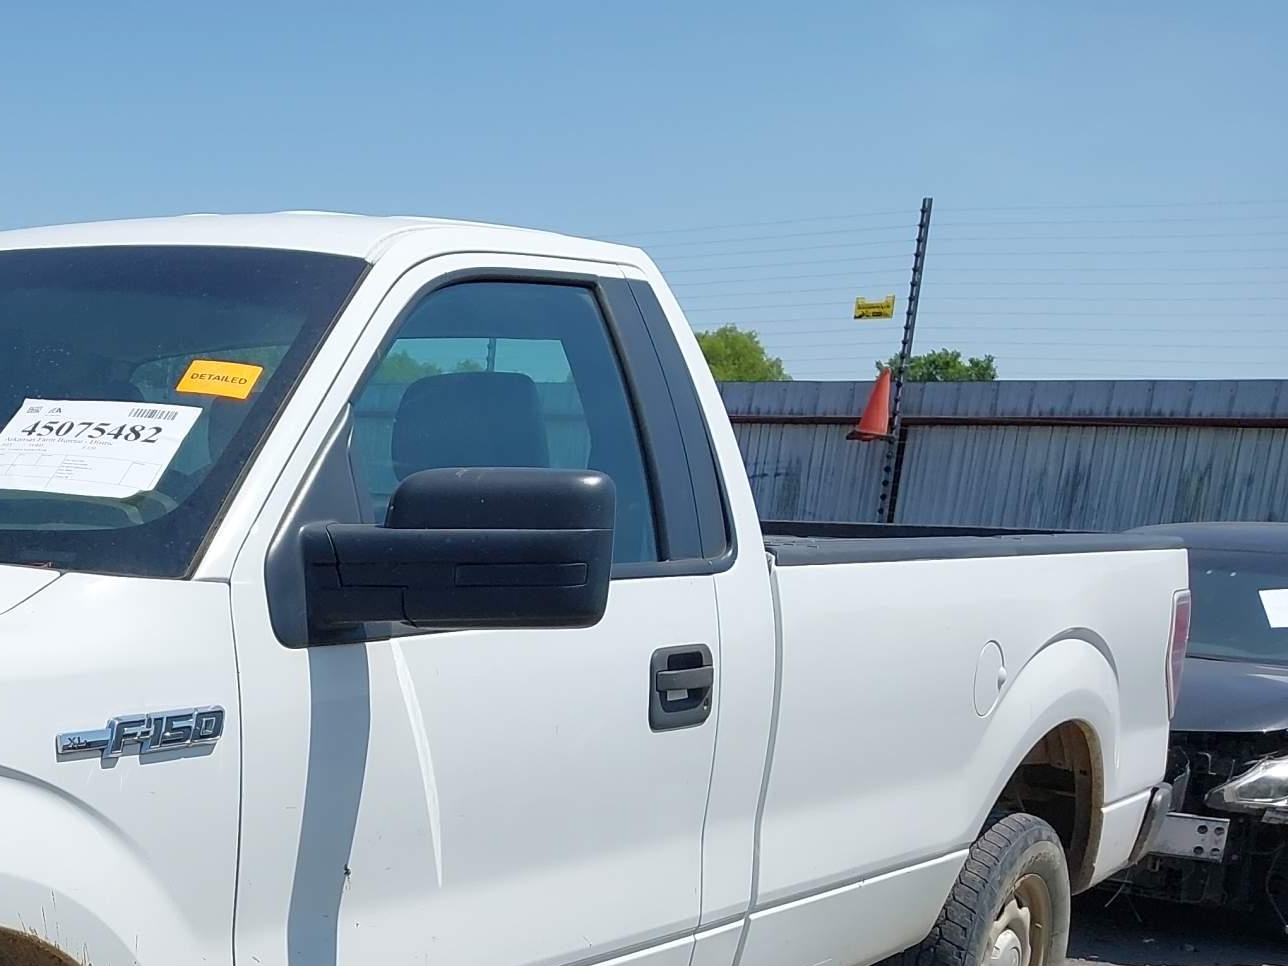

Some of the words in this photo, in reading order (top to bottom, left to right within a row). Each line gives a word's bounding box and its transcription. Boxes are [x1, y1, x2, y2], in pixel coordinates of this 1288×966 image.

[190, 373, 248, 385] DETAILED
[21, 420, 162, 443] 45075482
[68, 736, 88, 749] XL
[104, 704, 225, 758] F-150
